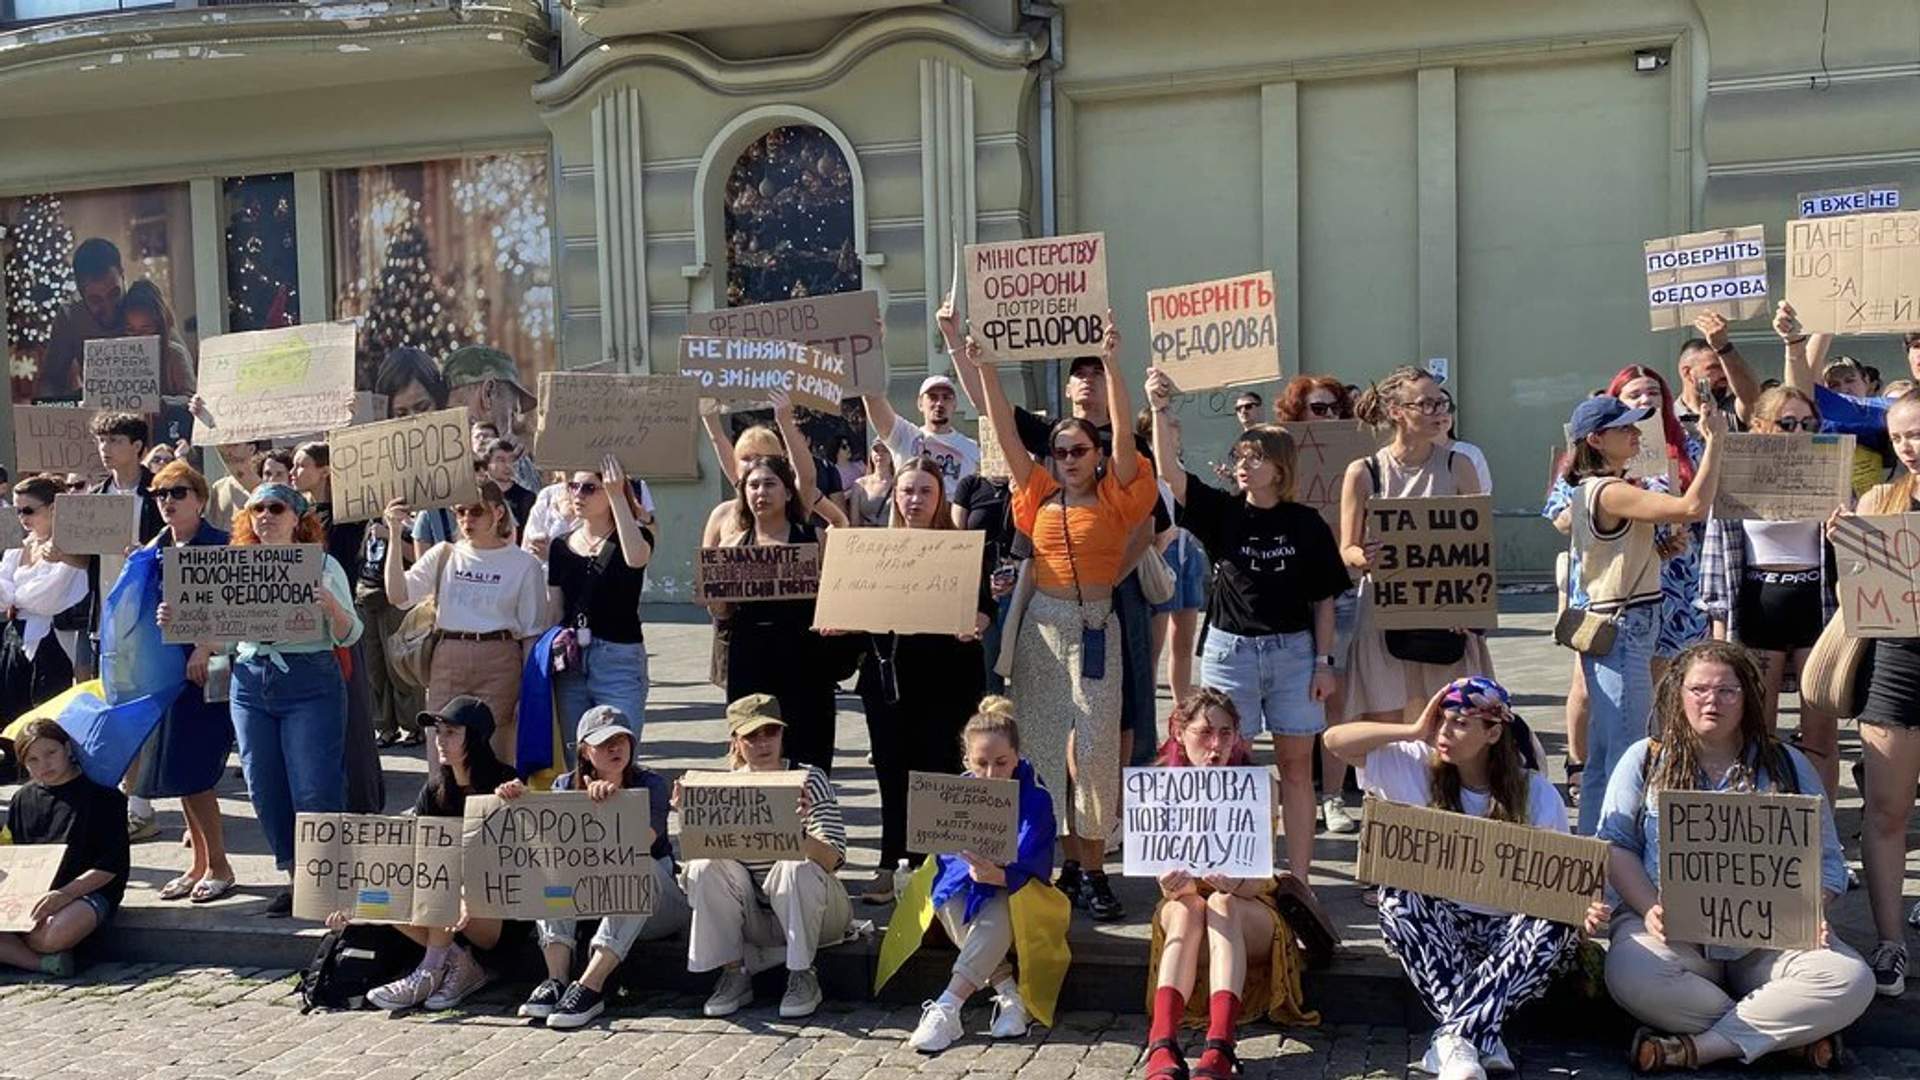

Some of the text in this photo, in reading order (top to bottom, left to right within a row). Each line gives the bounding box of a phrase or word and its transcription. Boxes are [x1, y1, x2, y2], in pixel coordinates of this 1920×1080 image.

[1803, 192, 1896, 214] Я ВЖЕ НЕ
[1793, 219, 1857, 251] ПАНЕ
[976, 239, 1098, 272] МІНІСТЕРСТВУ
[1649, 243, 1760, 269] ПОВЕРНІТЬ
[984, 270, 1087, 300] ОБОРОНИ
[1652, 280, 1766, 304] ФЕДОРОВА
[1825, 277, 1857, 298] ЗА
[708, 304, 820, 337] ФЕДОРОВ
[996, 298, 1079, 318] ПОТРІБЕН
[1847, 295, 1920, 323] Х#Й
[983, 315, 1104, 350] ФЕДОРОВ
[1152, 314, 1275, 362] ФЕДОРОВА
[688, 340, 722, 359] НЕ
[812, 349, 845, 375] ТИХ
[332, 423, 465, 480] ФЕДОРОВ
[1373, 509, 1479, 532] ТА ШО
[253, 548, 304, 566] КРАЩЕ
[701, 549, 716, 564] НЕ
[1378, 543, 1489, 570] З ВАМИ
[181, 565, 290, 585] ПОЛОНЕНИХ
[1374, 573, 1493, 606] НЕ ТАК?
[1780, 570, 1820, 584] PRO
[179, 591, 189, 604] А
[196, 591, 213, 604] НЕ
[684, 786, 767, 807] ПОЯСНІТЬ
[940, 791, 1012, 808] ФЕДОРОВА
[1127, 770, 1257, 805] ФЕДОРОВА
[481, 806, 621, 845] КАДРОВІ
[684, 804, 774, 826] ПРИЧИНУ
[1127, 806, 1256, 833] ПОВЕРНИ НА
[1669, 803, 1816, 847] РЕЗУЛЬТАТ
[1141, 833, 1257, 868] ПОСАДУ!!!
[306, 858, 450, 890] ФЕДОРОВА
[1495, 842, 1606, 897] ФЕДОРОВА
[1668, 851, 1803, 889] ПОТРЕБУЄ
[484, 872, 522, 905] НЕ
[1700, 897, 1772, 940] ЧАСУ
